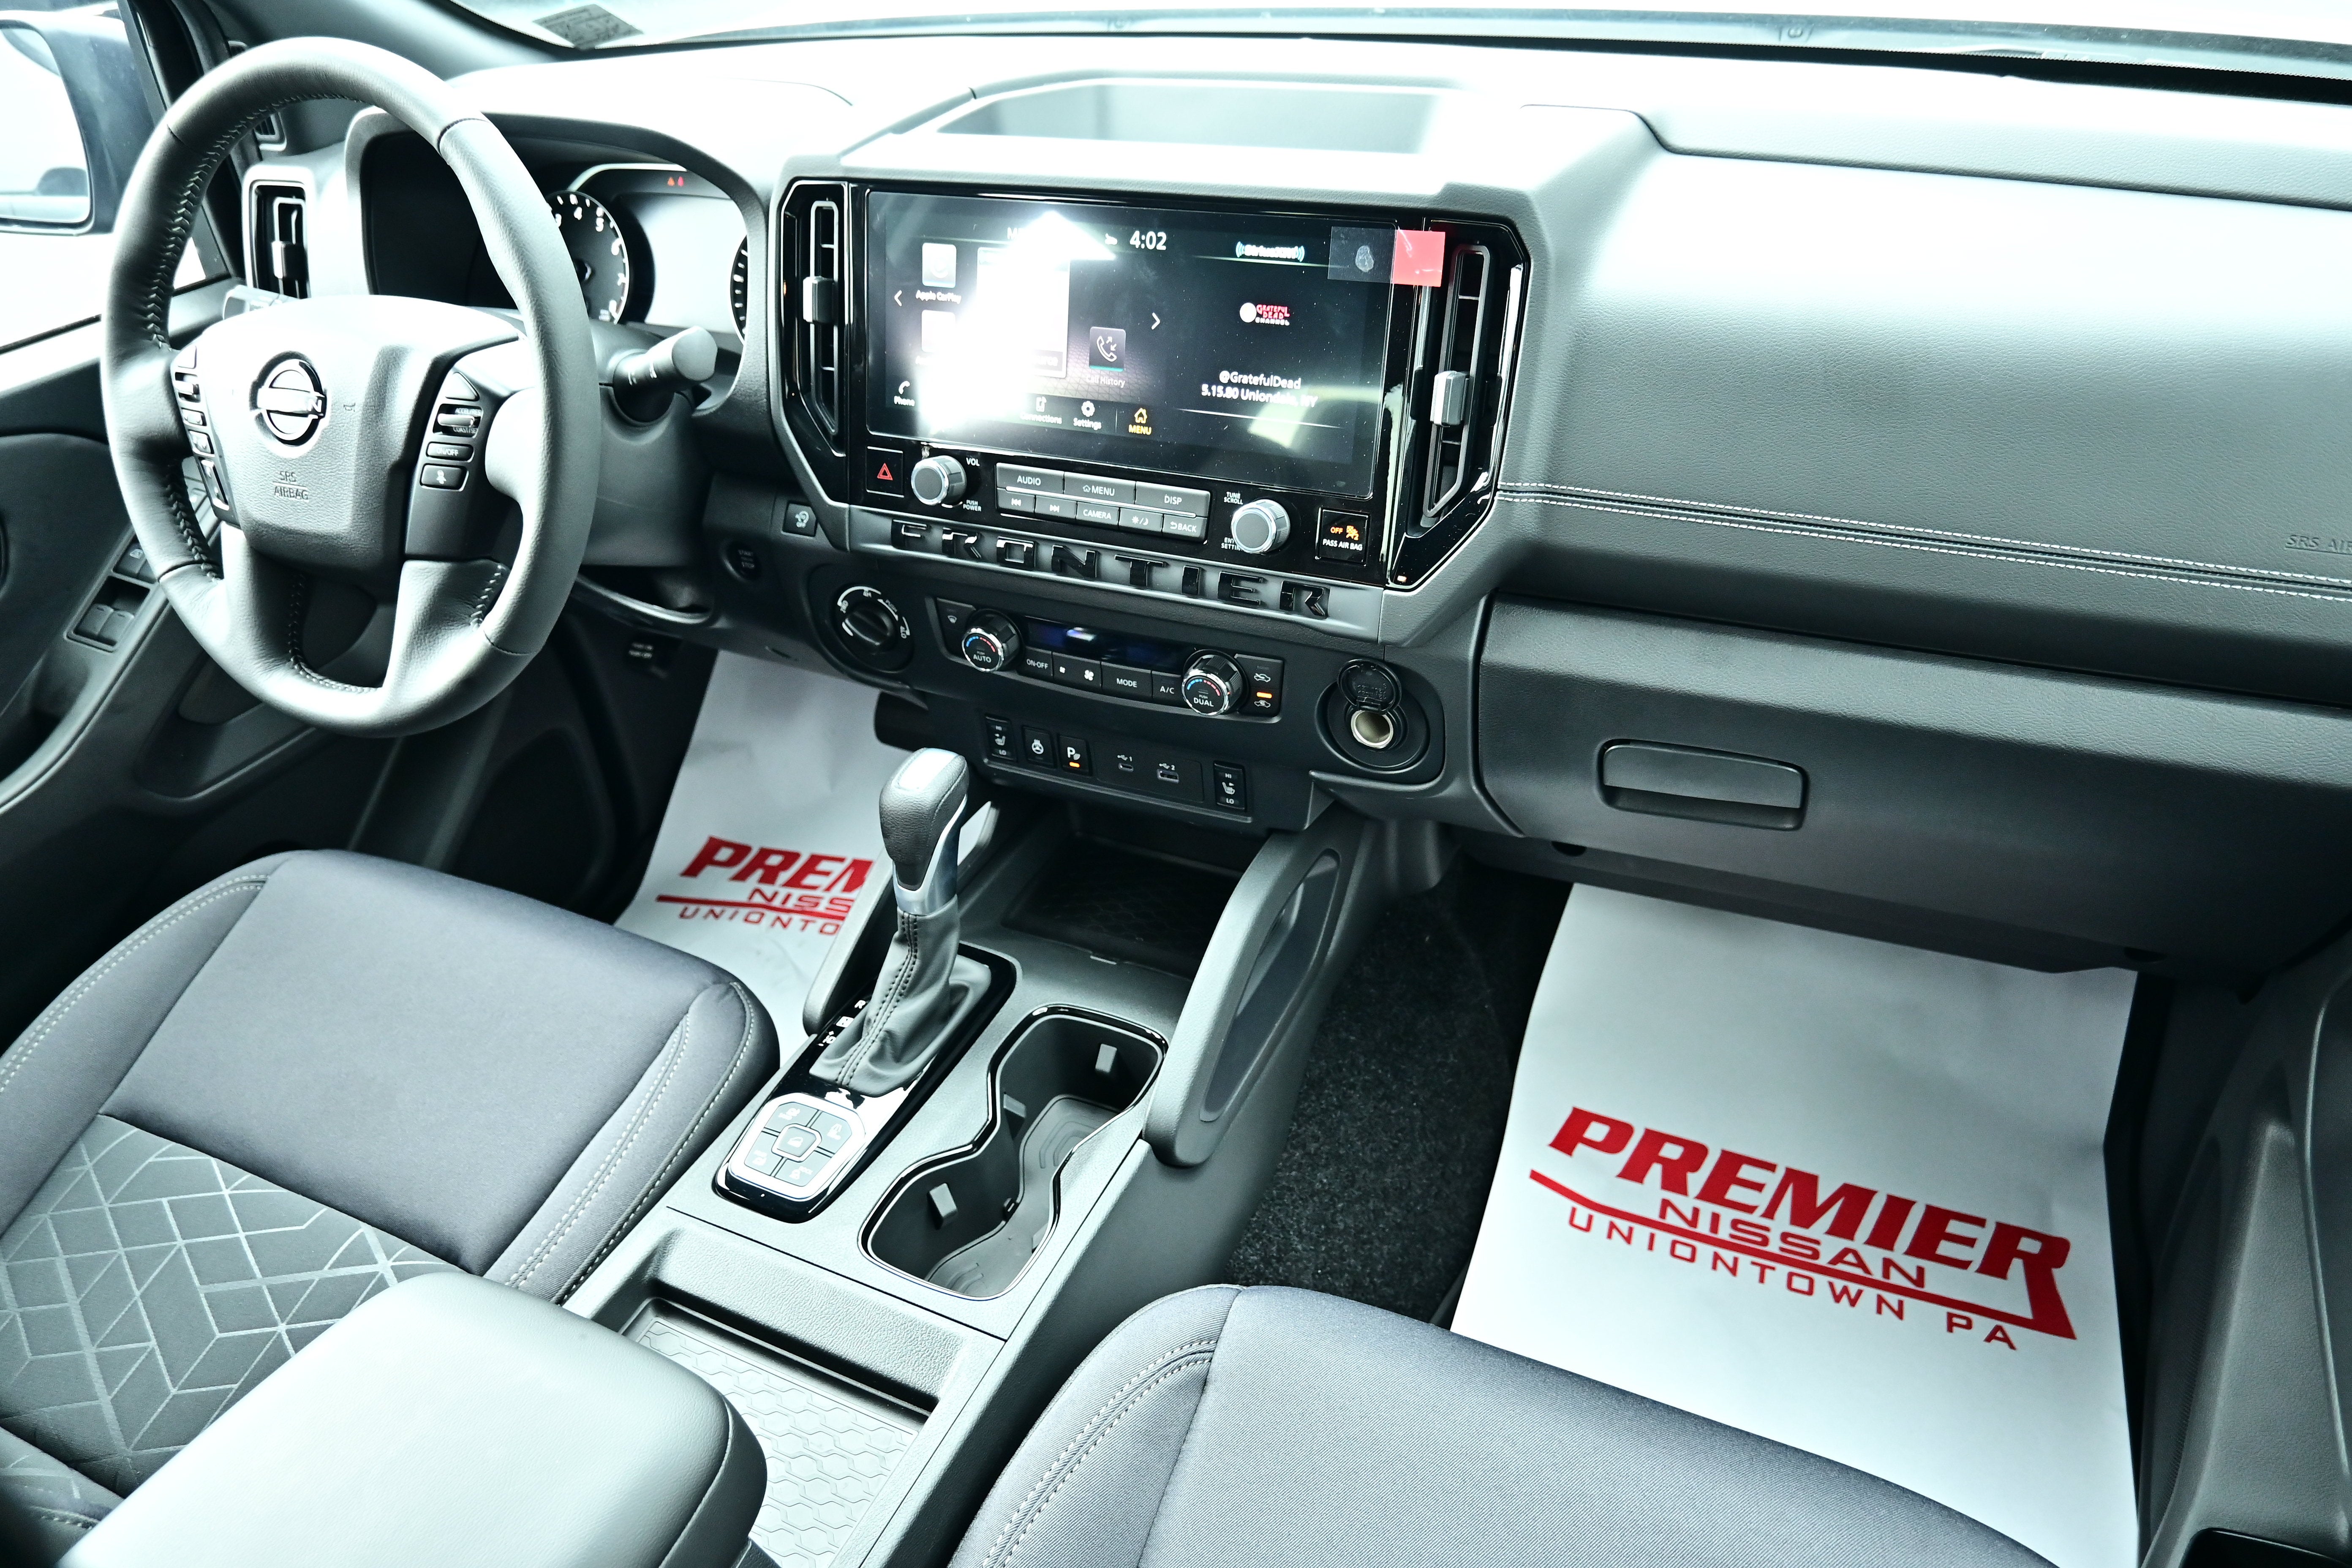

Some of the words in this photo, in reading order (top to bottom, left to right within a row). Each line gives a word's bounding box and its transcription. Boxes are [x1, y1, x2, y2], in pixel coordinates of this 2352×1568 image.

[1130, 231, 1167, 250] 4:02
[915, 289, 936, 302] Apple
[936, 291, 962, 305] CarPlay
[1256, 304, 1290, 318] GRATEFUL
[1263, 310, 1284, 320] DEAD
[1255, 317, 1290, 326] CHANNEL
[1086, 376, 1099, 385] Call
[1100, 377, 1125, 388] History
[1219, 370, 1301, 390] @GratefulDead
[893, 396, 915, 408] Phone
[1201, 384, 1239, 400] 5.15.80
[1300, 395, 1318, 408] NY
[1019, 411, 1063, 425] Connections
[1073, 417, 1102, 431] Settings
[1128, 424, 1152, 436] MENU
[436, 447, 459, 457] ON/OFF
[966, 457, 980, 467] VOL
[279, 470, 297, 483] SRS
[1017, 475, 1042, 486] AUDIO
[274, 485, 309, 501] AIRBAG
[1091, 485, 1115, 497] MENU
[1226, 491, 1241, 499] TUNE
[1164, 495, 1182, 505] DISP
[1223, 496, 1244, 505] SCROLL
[963, 504, 982, 512] POWER
[1083, 509, 1112, 520] CAMERA
[1178, 523, 1197, 533] BACK
[1330, 526, 1343, 534] OFF
[1221, 542, 1241, 551] SETTIN
[1323, 538, 1338, 547] PASS
[1338, 541, 1349, 549] AIR
[1350, 542, 1363, 551] BAG
[2284, 534, 2319, 549] SRS
[891, 519, 1331, 619] FRONTIER
[973, 654, 992, 663] AUTO
[1026, 658, 1048, 670] ON-OFF
[1116, 677, 1138, 689] MODE
[1160, 684, 1175, 695] A/C
[1193, 697, 1214, 707] DUAL
[1067, 746, 1076, 759] P
[680, 835, 874, 893] PREM
[748, 887, 855, 913] NISS
[679, 905, 841, 936] UNIONTO
[854, 999, 866, 1009] R
[1548, 1106, 2077, 1340] PREMIER
[1658, 1198, 1926, 1289] NISSAN
[1568, 1206, 1904, 1321] UNIONTOWN
[1946, 1311, 2017, 1351] PA
